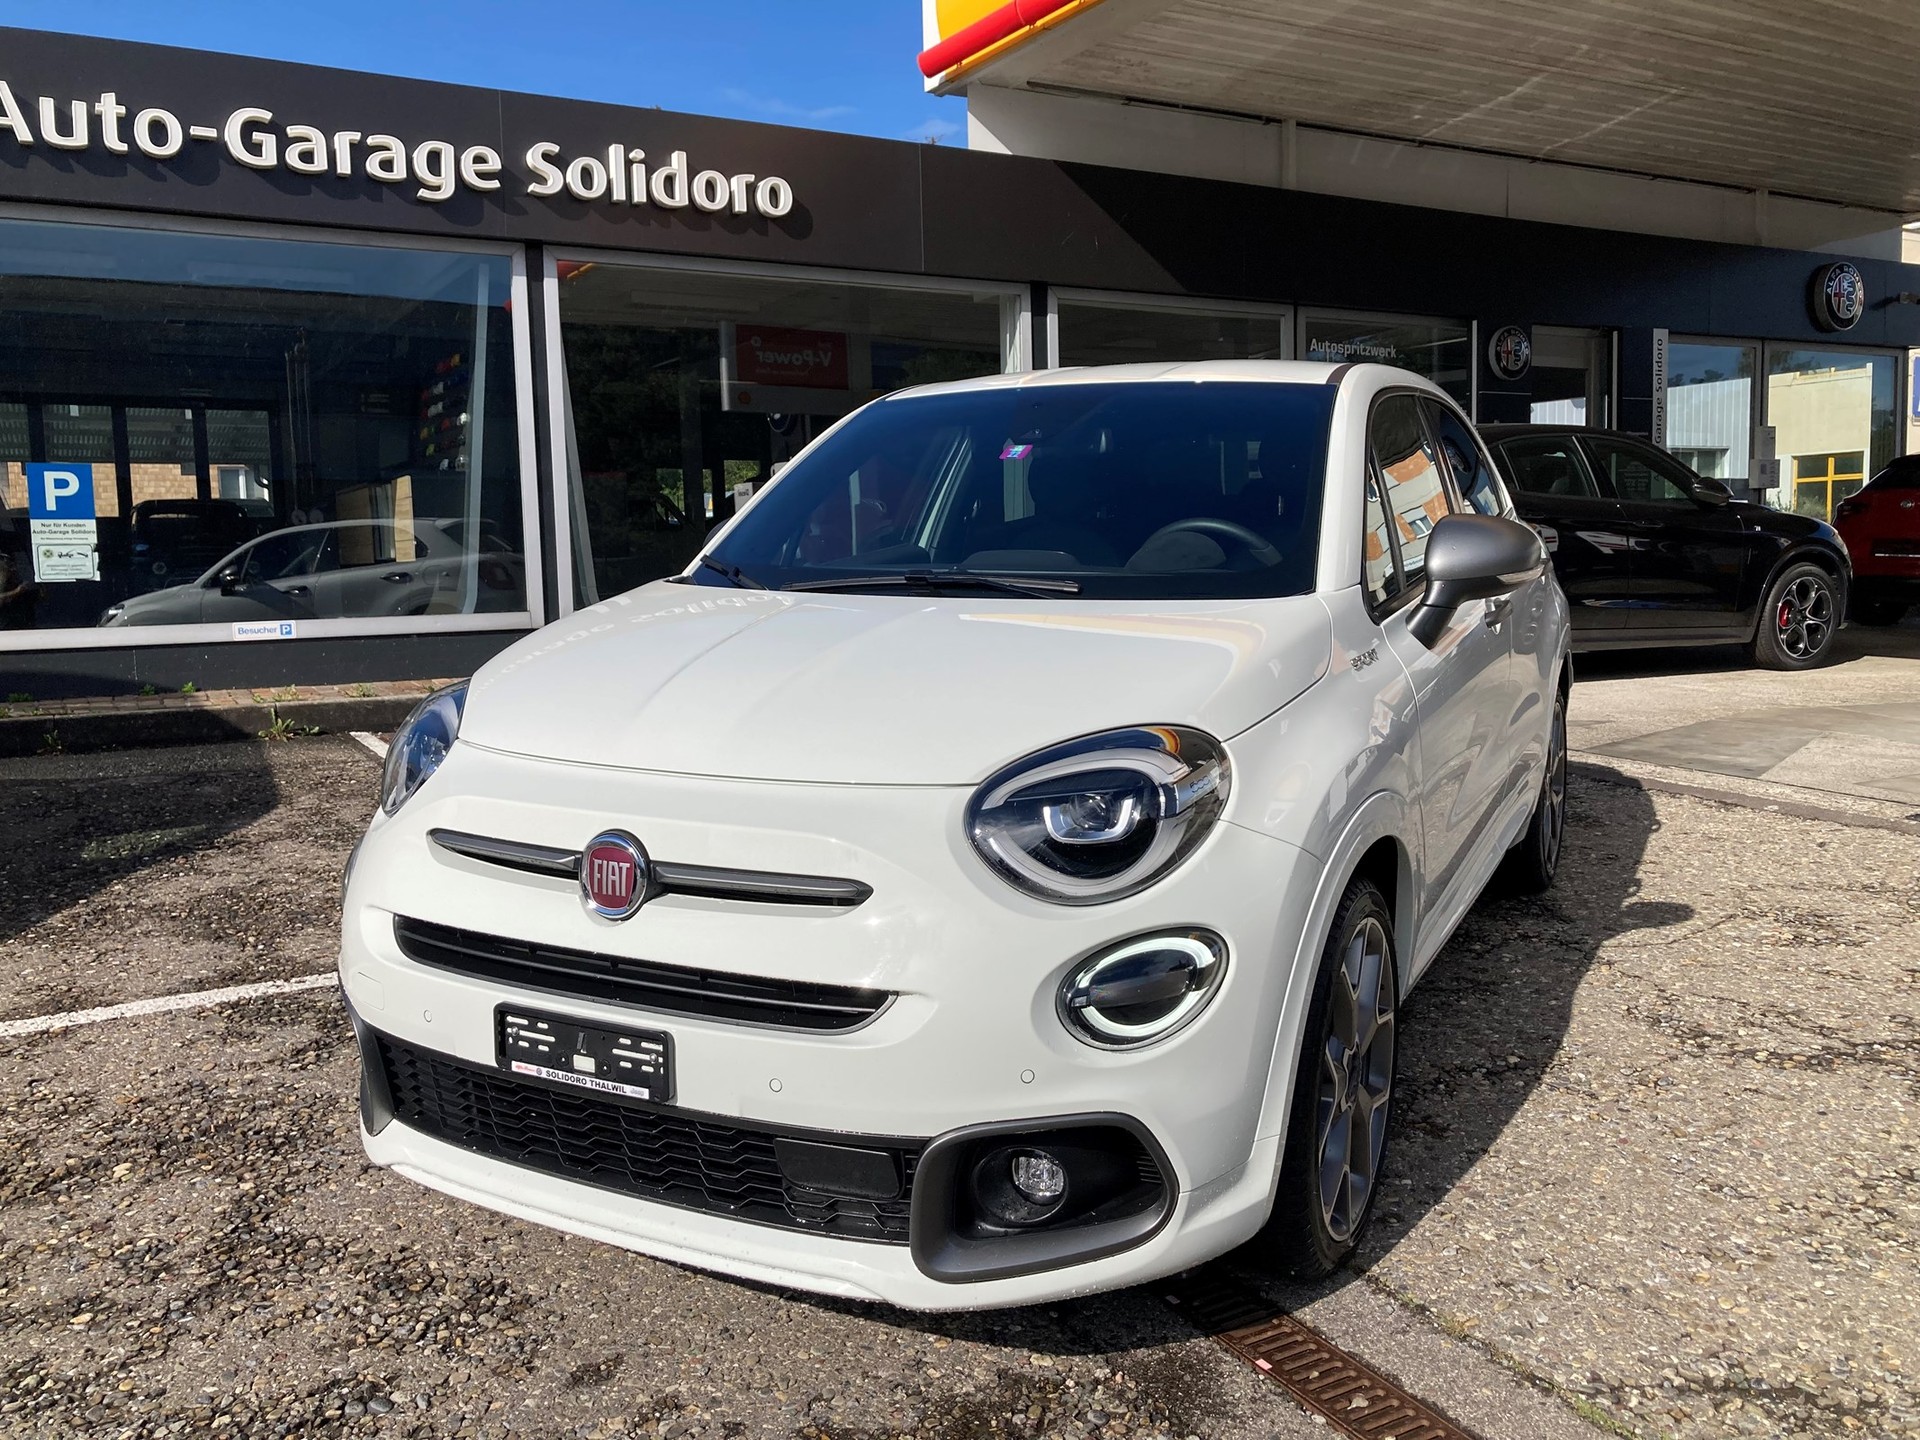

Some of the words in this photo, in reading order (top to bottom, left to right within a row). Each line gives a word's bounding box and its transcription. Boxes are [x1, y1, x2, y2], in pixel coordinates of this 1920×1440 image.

[0, 80, 502, 203] Auto-Garage
[526, 141, 794, 218] Solidoro
[1310, 338, 1397, 358] Autospritzwerk
[1655, 338, 1664, 393] Solidoro
[1654, 397, 1664, 444] Garage
[44, 471, 80, 511] P
[237, 626, 278, 635] Besucher
[592, 857, 631, 897] FIAT
[545, 1069, 587, 1086] SOLIDORO
[589, 1079, 627, 1094] THALWIL
